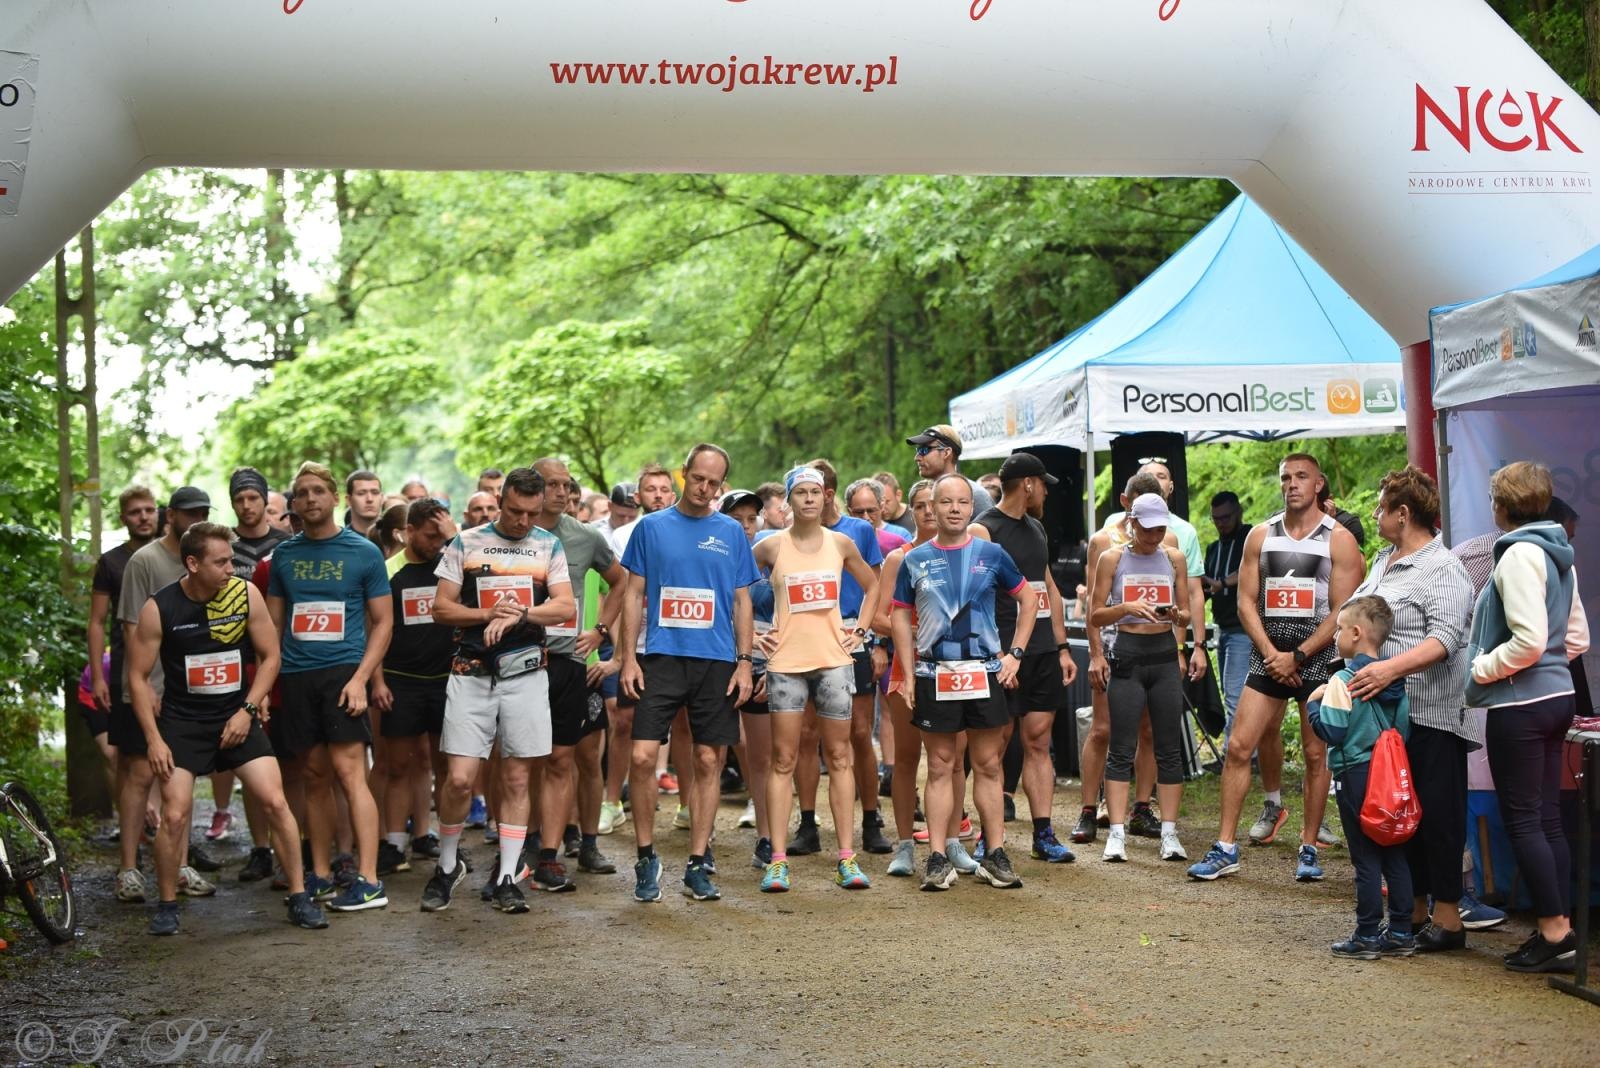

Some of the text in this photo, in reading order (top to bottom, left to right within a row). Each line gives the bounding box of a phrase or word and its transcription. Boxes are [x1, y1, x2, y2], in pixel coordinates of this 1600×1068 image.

[550, 55, 899, 92] www.twojakrew.pl
[1411, 82, 1585, 154] NCK
[1408, 177, 1592, 188] NARODOWE CENTRUM KRWI
[1442, 336, 1499, 374] PersonalBest
[1123, 383, 1316, 413] PersonalBest
[958, 408, 1005, 442] ersonalBest
[293, 559, 344, 581] RUN
[802, 583, 826, 601] 83
[1136, 586, 1159, 603] 23
[1277, 590, 1299, 608] 31
[670, 601, 706, 619] 100
[306, 614, 330, 632] 79
[203, 666, 228, 685] 55
[950, 673, 975, 691] 32
